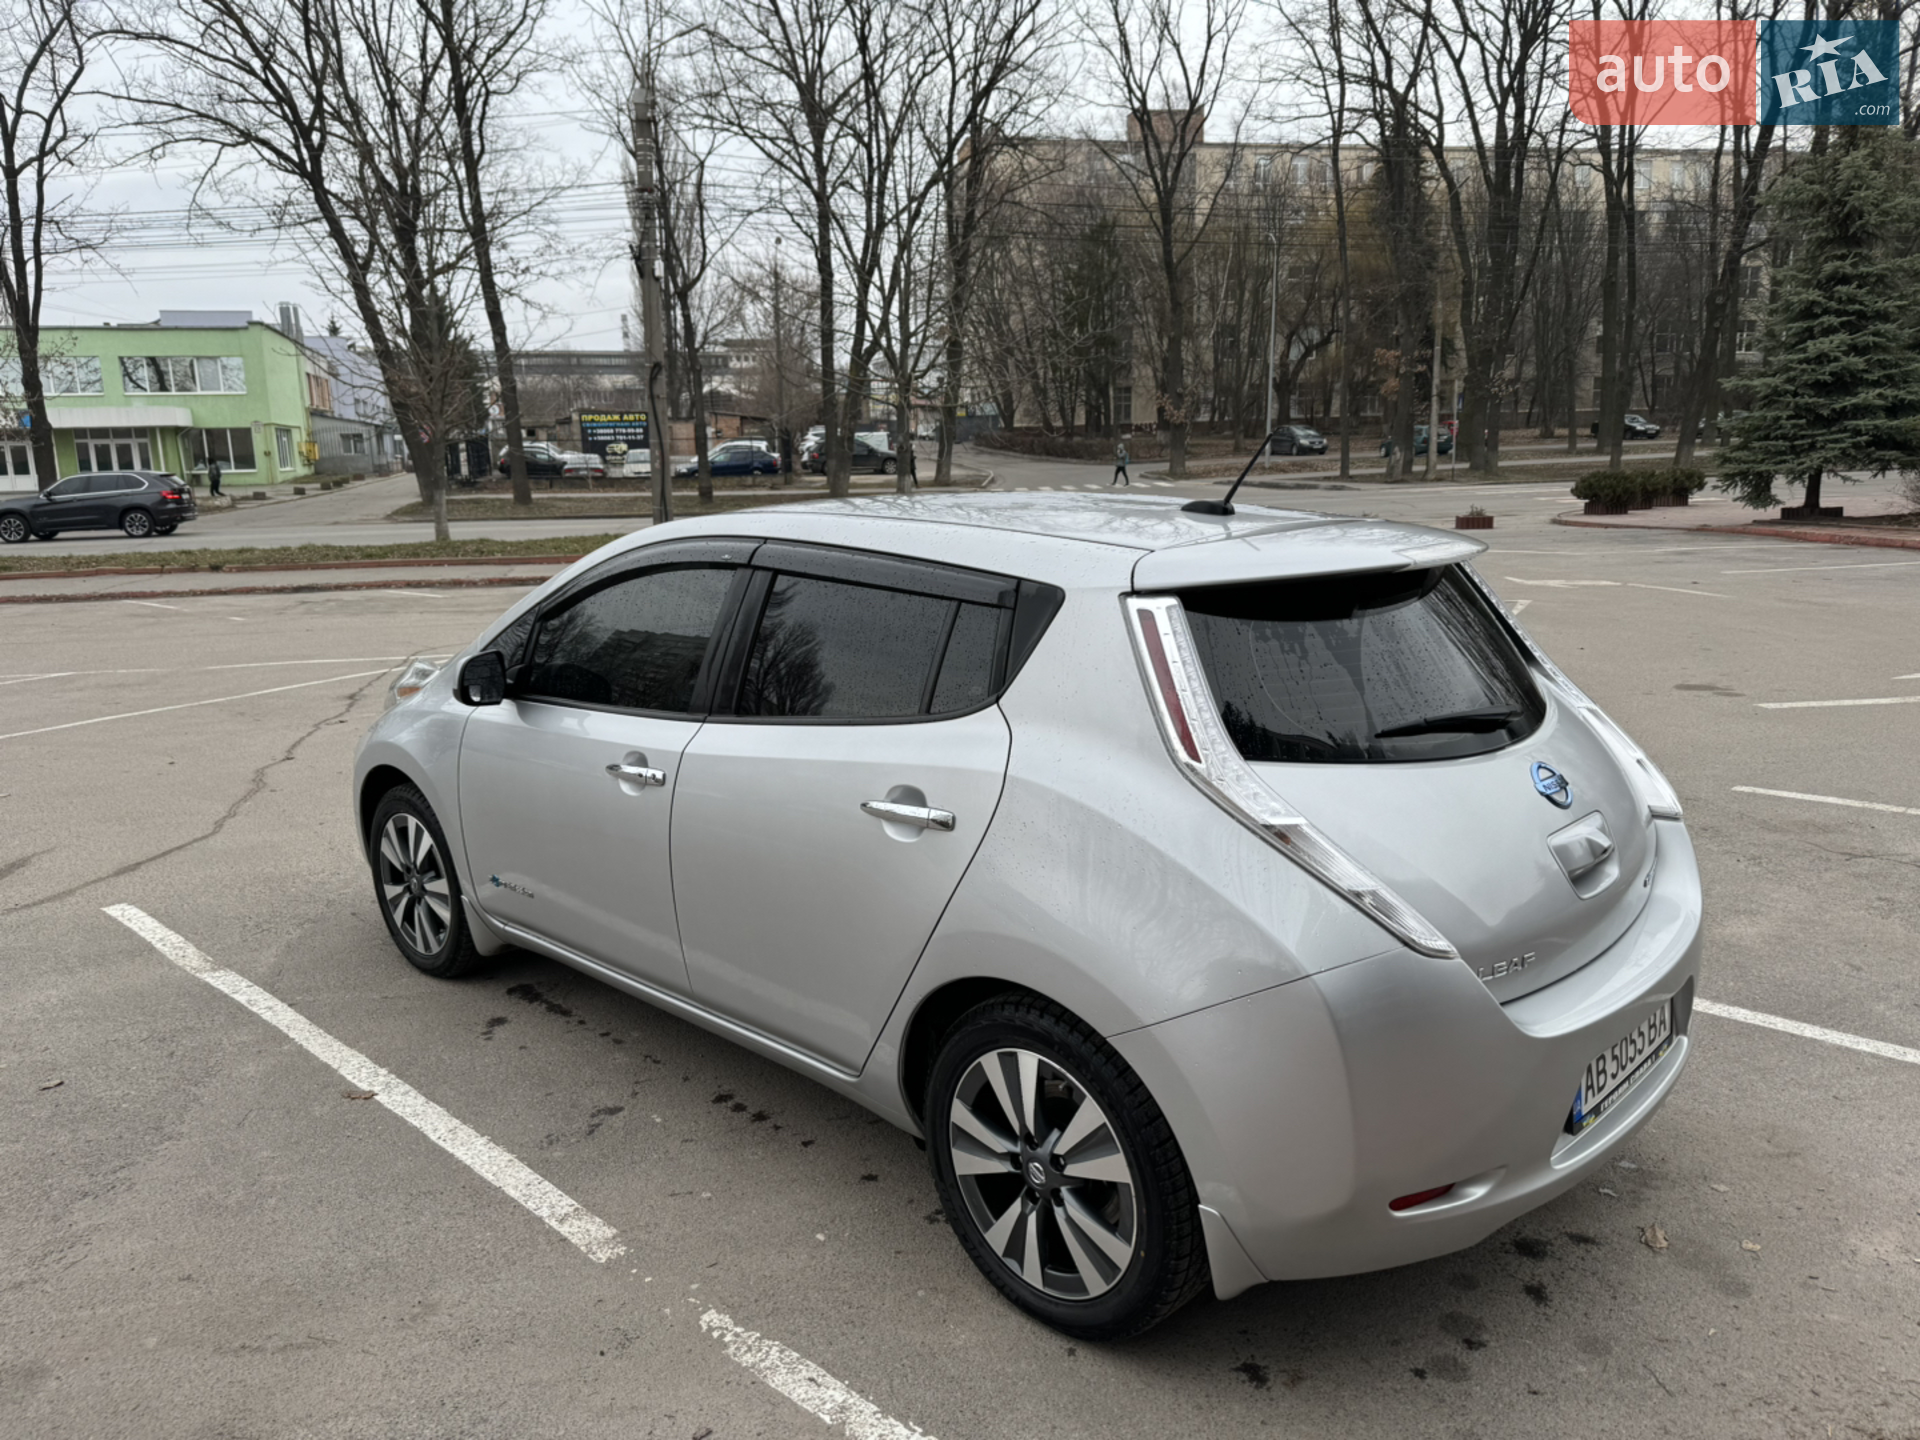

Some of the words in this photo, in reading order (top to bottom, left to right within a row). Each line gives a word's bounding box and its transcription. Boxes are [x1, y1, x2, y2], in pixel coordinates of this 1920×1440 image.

[581, 414, 620, 422] ПРОДАЖ
[623, 413, 646, 421] АВТО
[1478, 952, 1536, 981] LEAF
[1584, 1053, 1608, 1105] AB
[1611, 1026, 1646, 1081] 5055
[1648, 1006, 1667, 1048] BA
